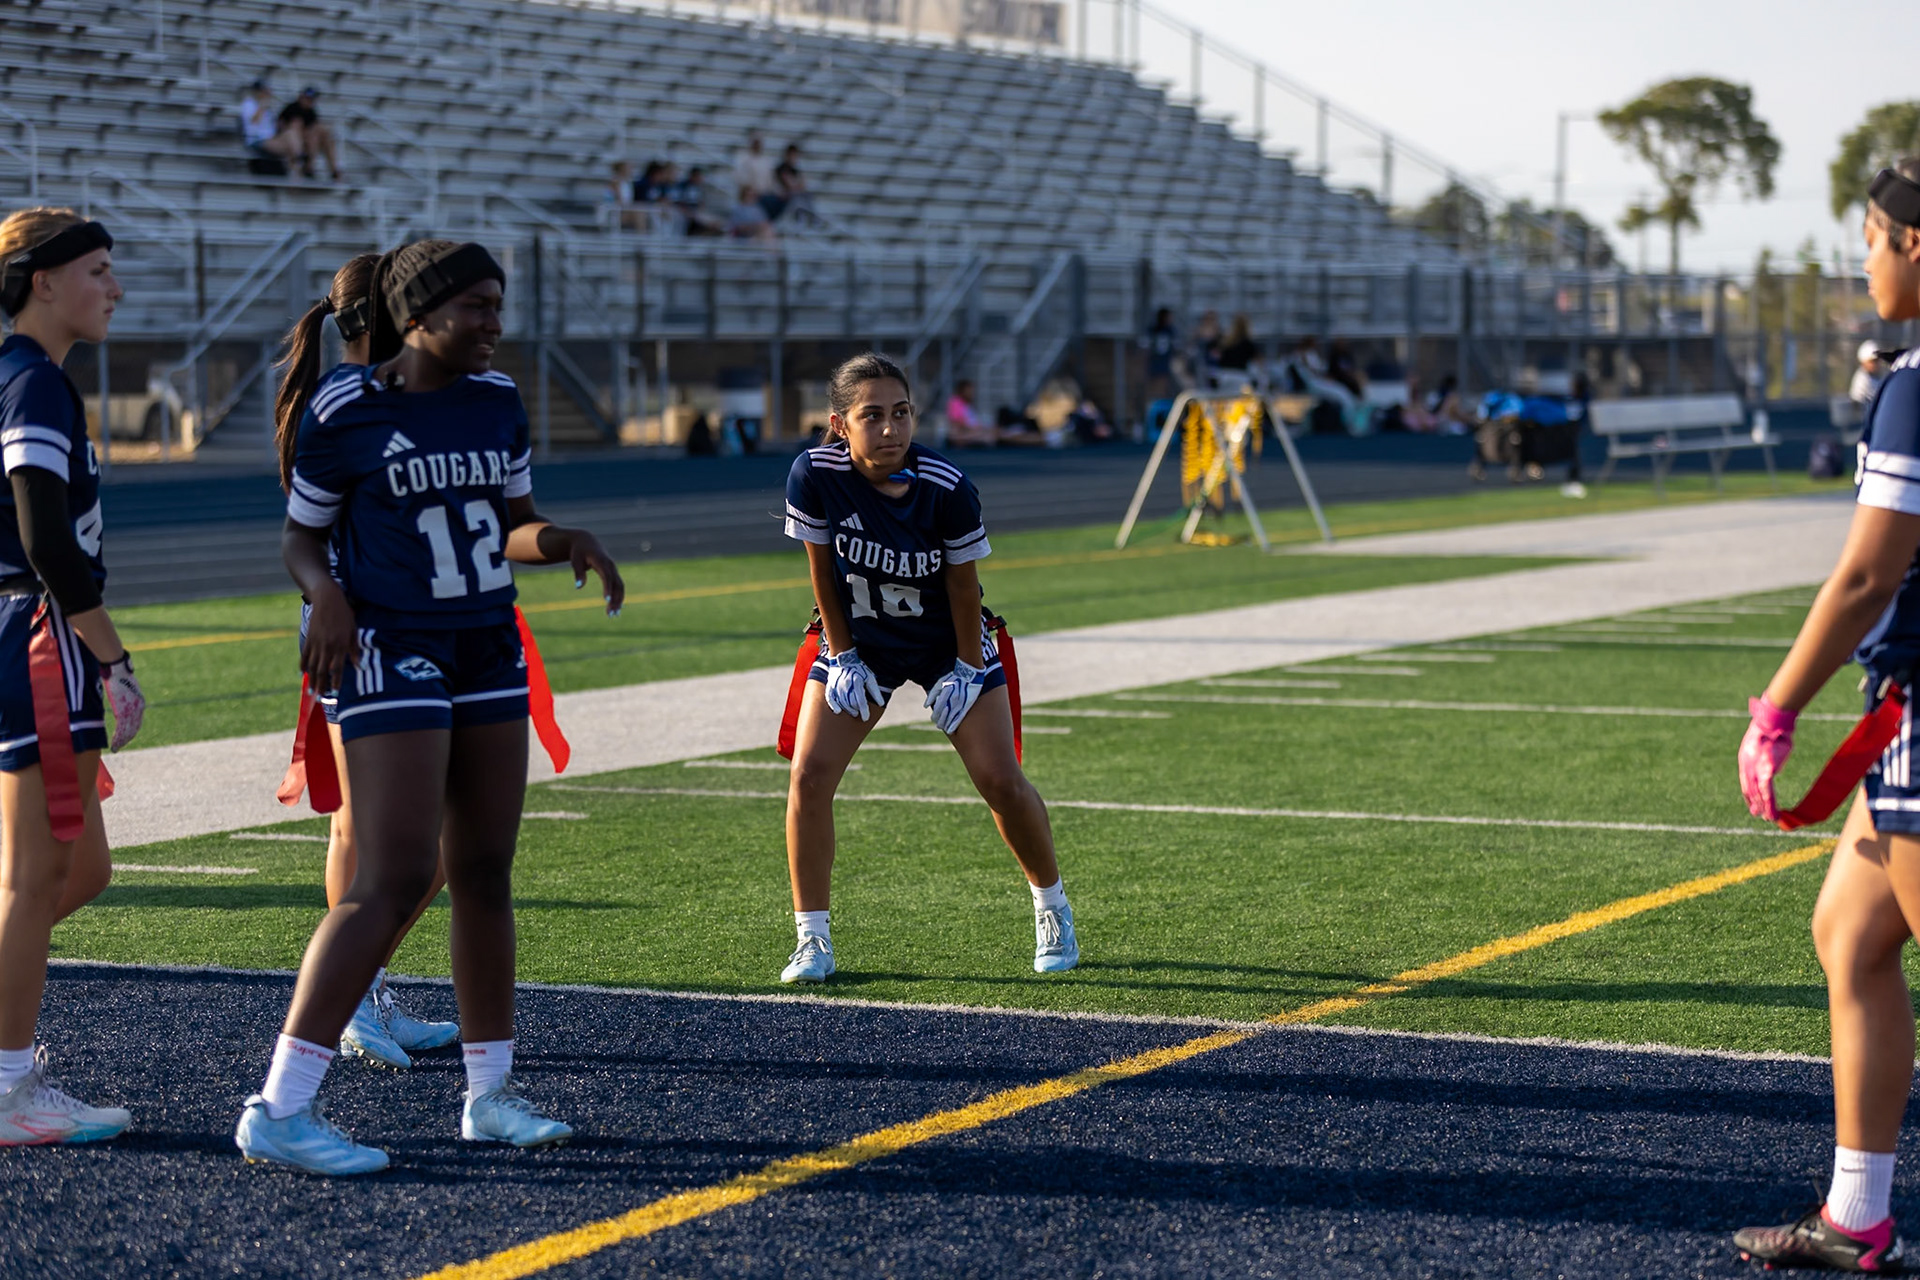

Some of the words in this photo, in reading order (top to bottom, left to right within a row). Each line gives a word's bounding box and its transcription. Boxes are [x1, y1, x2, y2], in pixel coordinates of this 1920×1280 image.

[387, 450, 511, 497] COUGARS
[416, 499, 513, 599] 12
[835, 532, 942, 578] COUGARS
